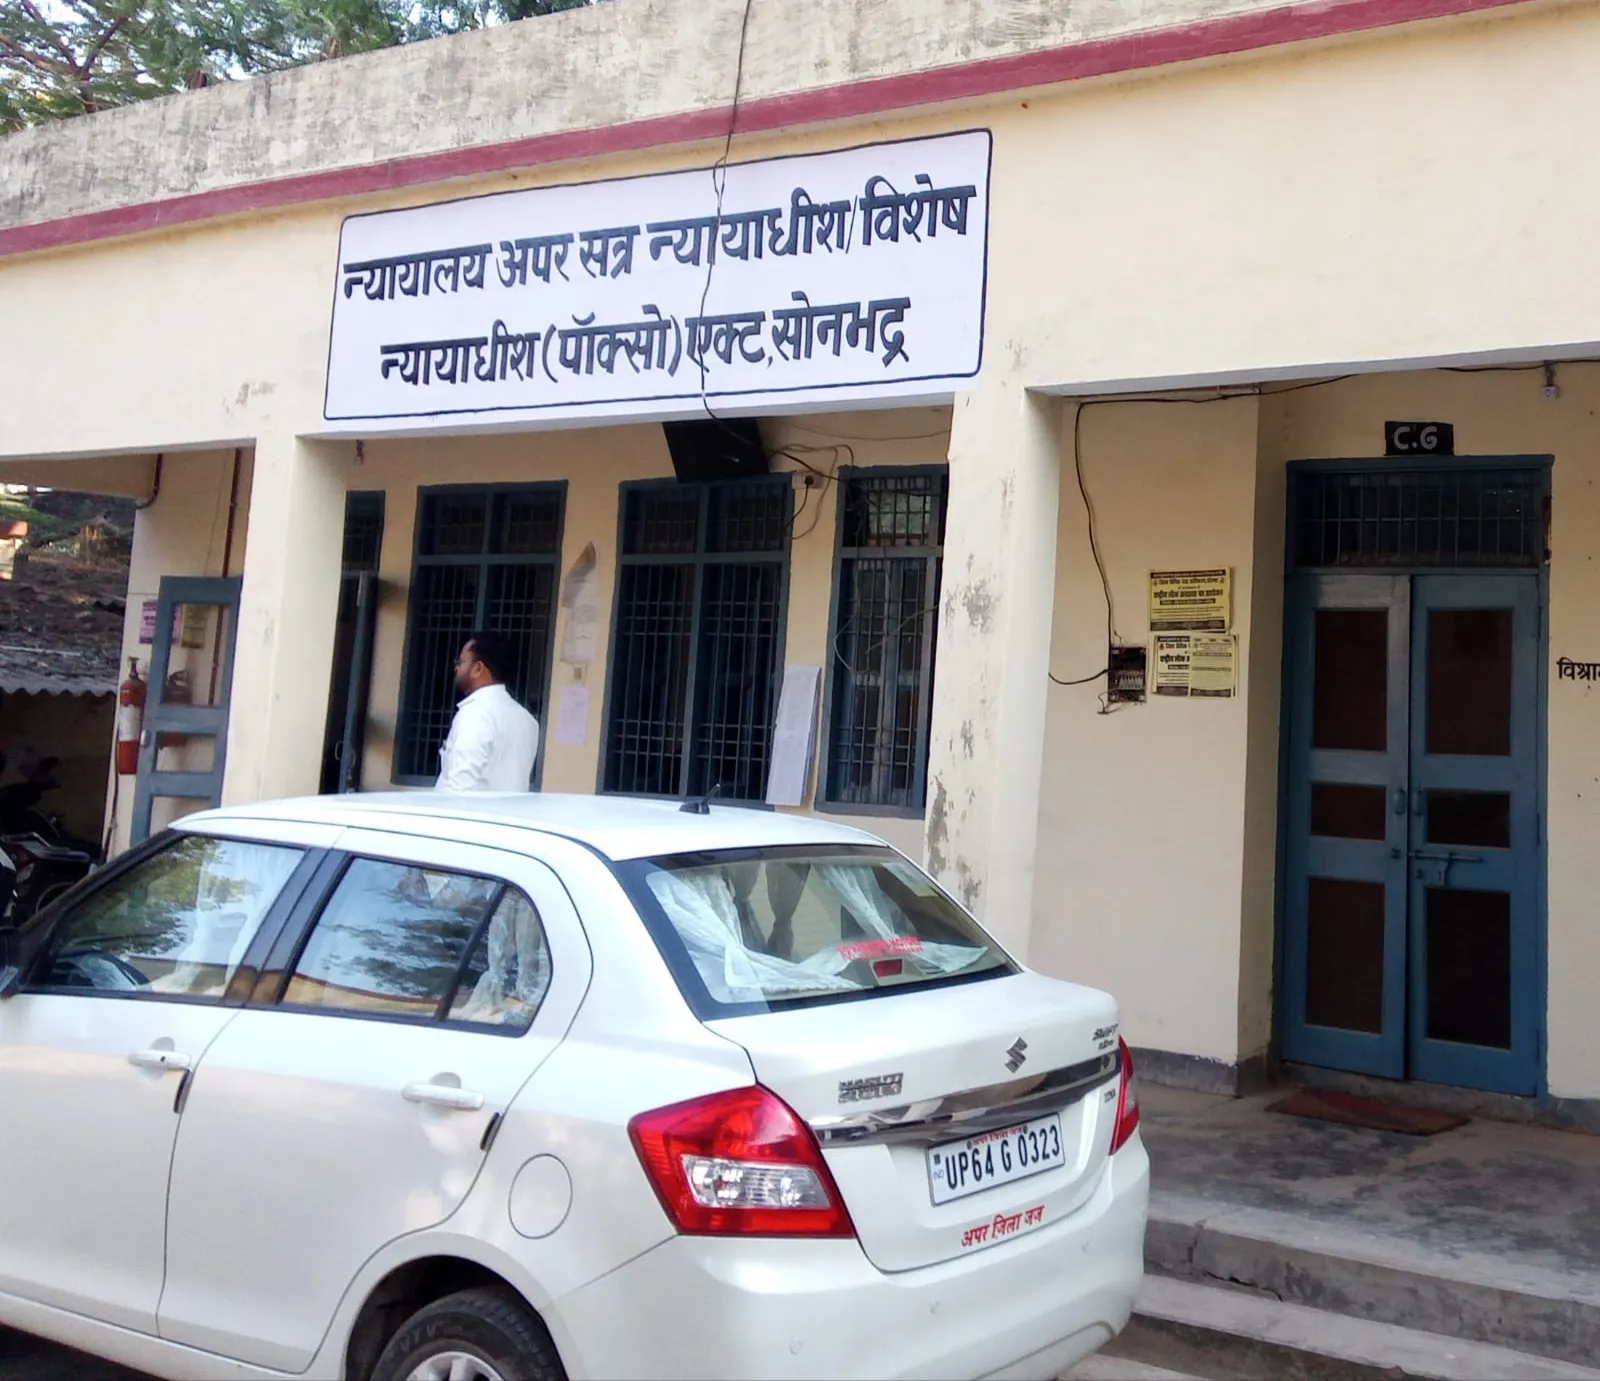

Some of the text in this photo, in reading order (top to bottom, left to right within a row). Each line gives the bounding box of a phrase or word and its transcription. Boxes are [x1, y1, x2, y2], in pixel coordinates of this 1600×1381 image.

[343, 243, 492, 300] न्यायालय
[497, 232, 574, 287] अपर
[579, 224, 641, 279] सत्र
[380, 319, 541, 386] न्यायाधीश
[771, 290, 911, 368] सोनभद्र
[1556, 656, 1600, 681] विश्रा
[945, 1143, 995, 1190] UP64
[1017, 1124, 1061, 1167] 0323
[961, 1223, 990, 1247] अपर
